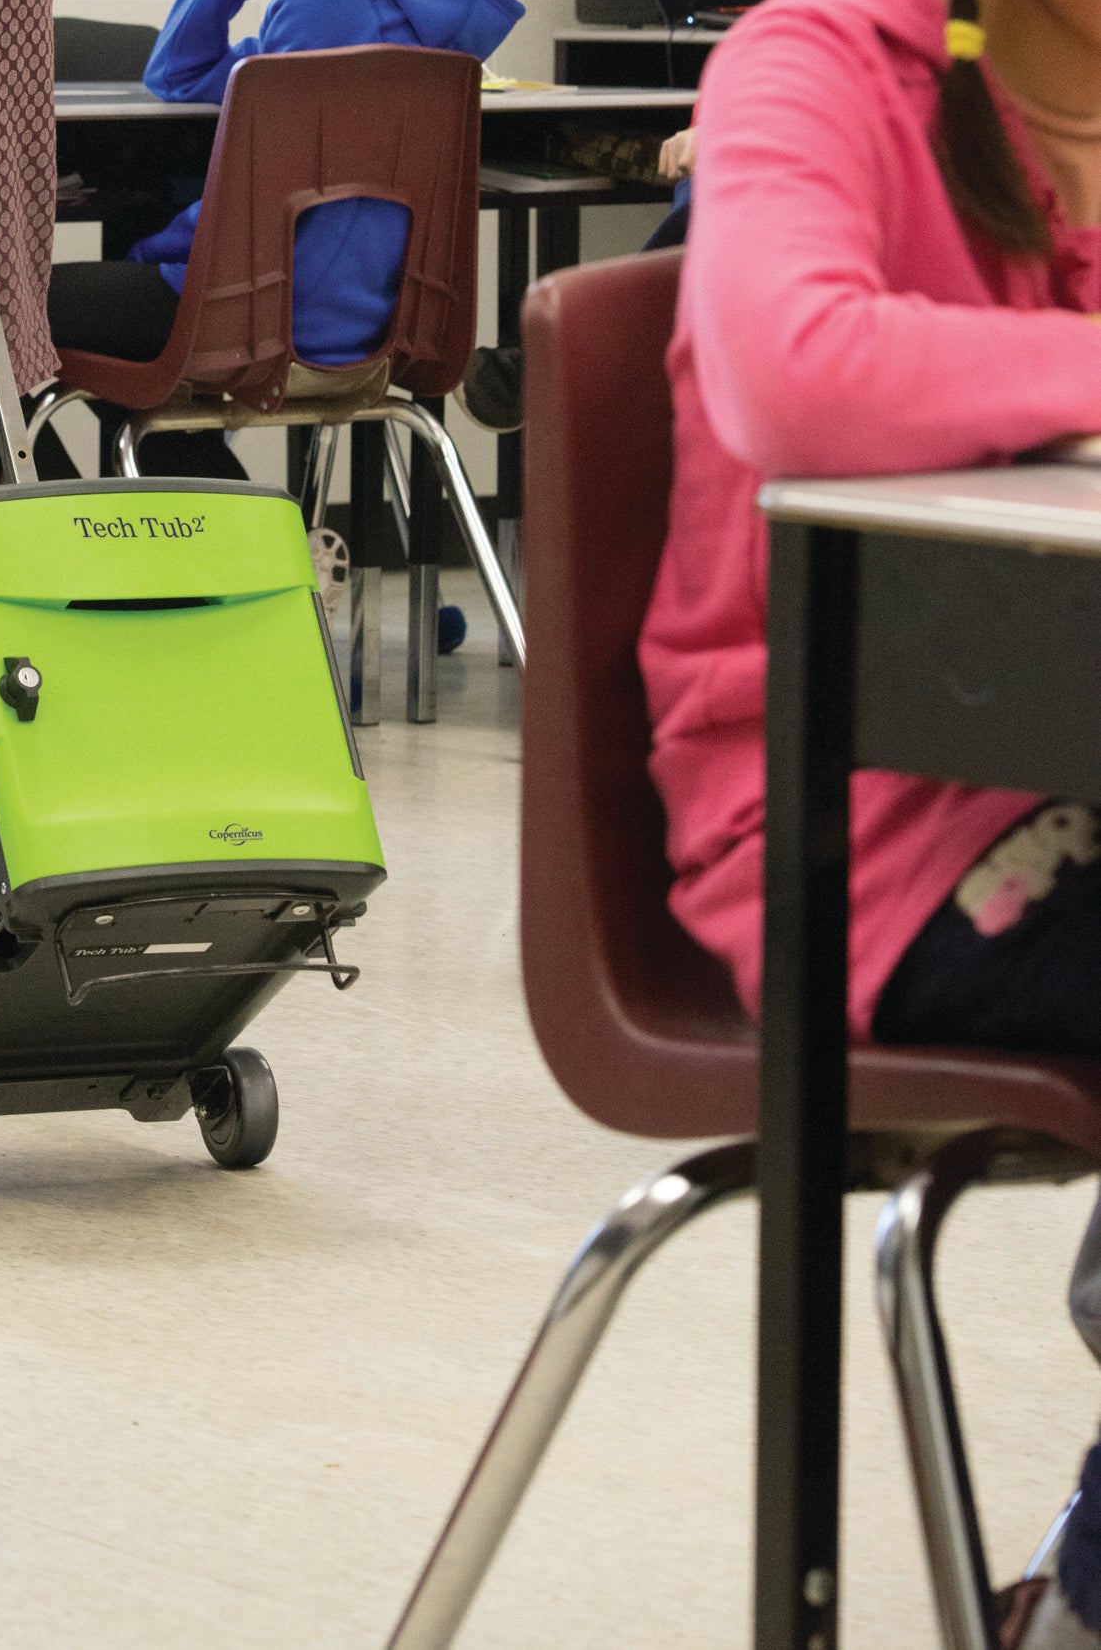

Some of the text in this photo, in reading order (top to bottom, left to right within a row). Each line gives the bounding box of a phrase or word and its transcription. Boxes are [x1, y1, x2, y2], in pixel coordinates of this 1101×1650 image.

[73, 516, 138, 538] Tech
[208, 827, 263, 841] Copernicus
[75, 948, 107, 957] Tech
